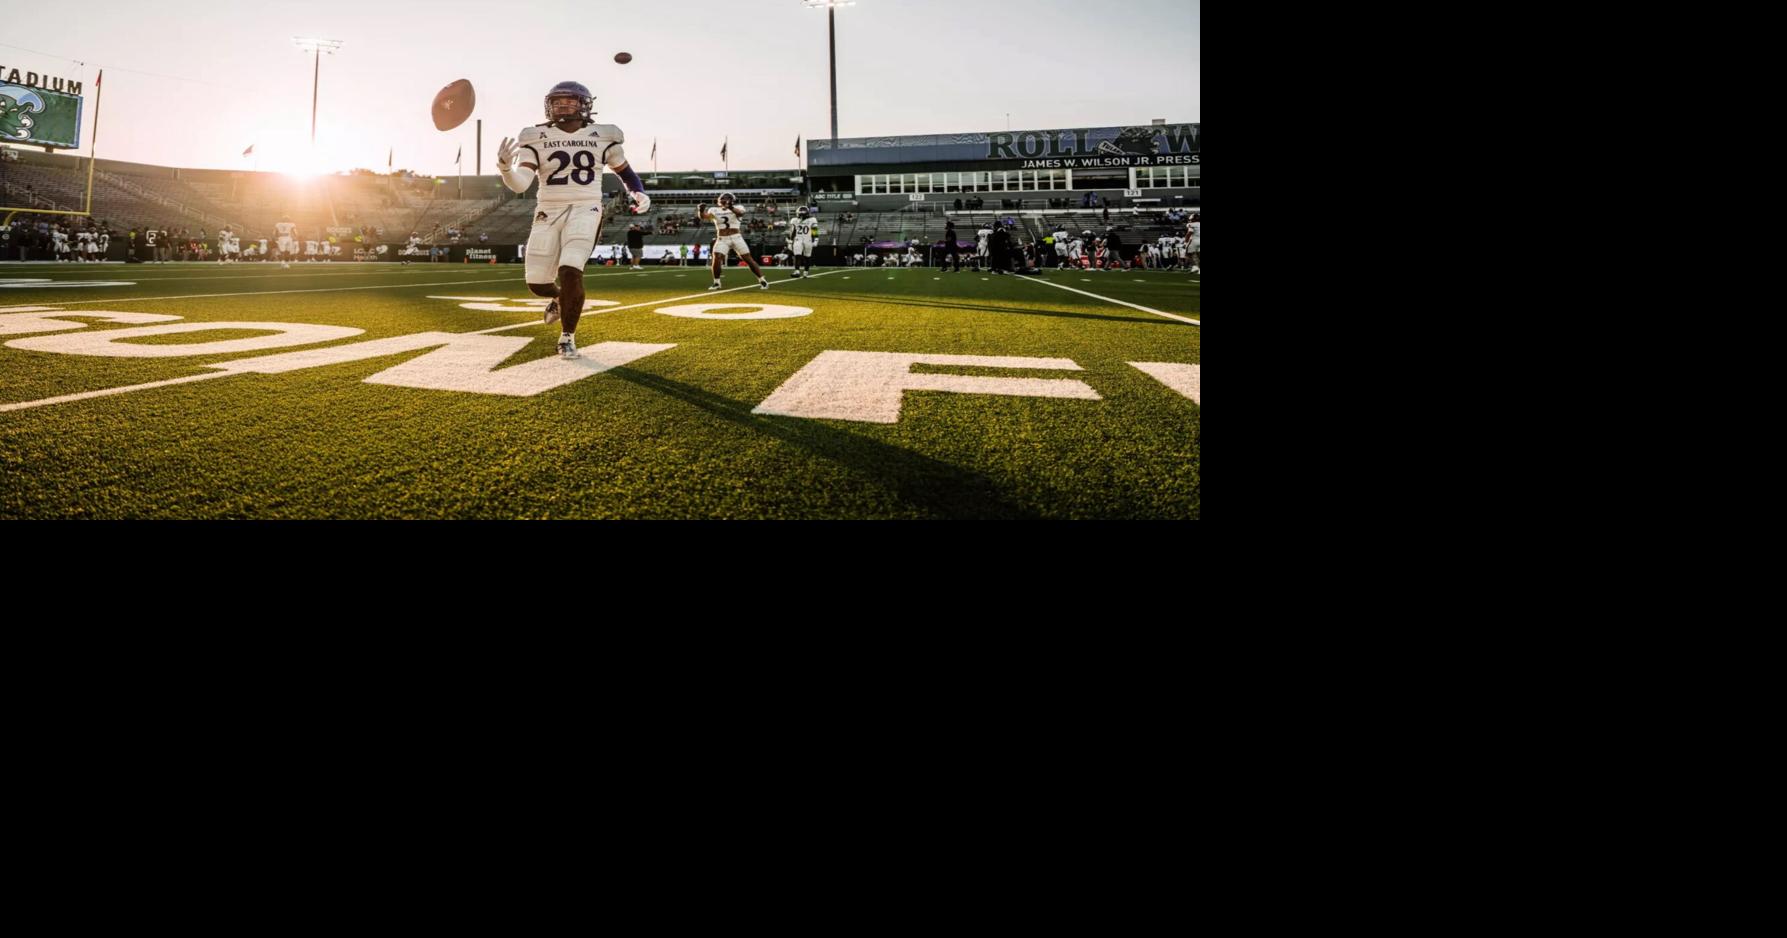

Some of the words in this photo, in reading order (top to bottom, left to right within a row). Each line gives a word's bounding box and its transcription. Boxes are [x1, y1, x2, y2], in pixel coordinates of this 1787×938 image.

[543, 141, 560, 149] EAST
[562, 140, 598, 148] CAROLINA
[986, 128, 1099, 159] ROLL
[546, 150, 595, 185] 28
[1021, 159, 1061, 169] JAMES
[1064, 158, 1078, 168] W.
[1081, 157, 1130, 167] WILSON
[1134, 156, 1153, 165] JR.
[1156, 154, 1200, 164] PRESS
[720, 216, 730, 229] 3
[797, 225, 809, 235] 20
[466, 247, 491, 256] planet
